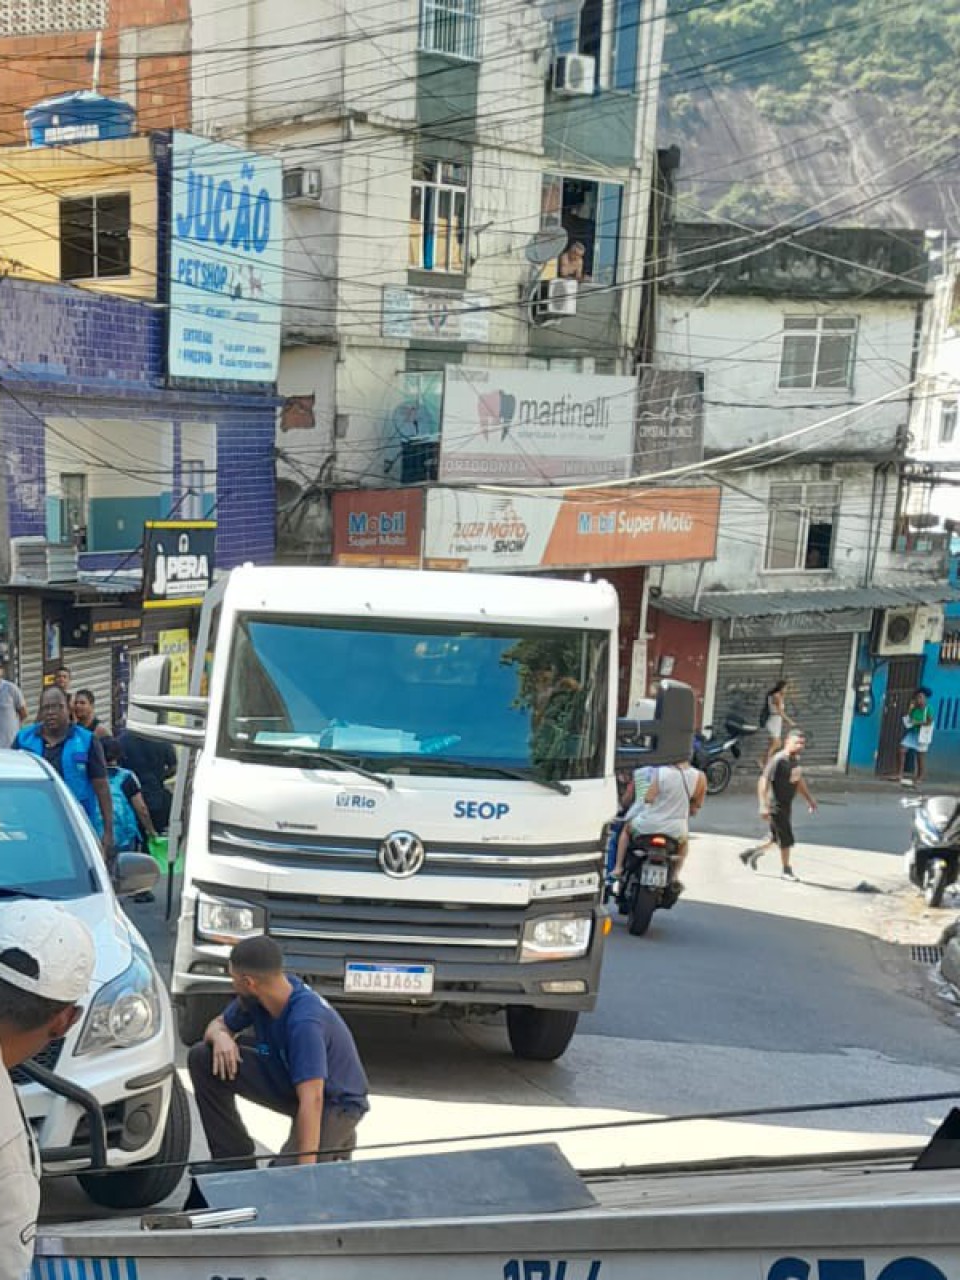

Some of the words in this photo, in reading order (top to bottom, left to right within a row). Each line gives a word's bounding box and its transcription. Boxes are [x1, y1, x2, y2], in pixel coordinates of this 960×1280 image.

[176, 161, 271, 253] JUCÃO
[519, 393, 609, 429] martinelli
[349, 512, 406, 534] Mobil
[617, 512, 656, 538] Super
[657, 511, 693, 533] Moto
[493, 539, 526, 553] SHOW
[351, 794, 376, 809] Rio
[453, 800, 510, 820] SEOP
